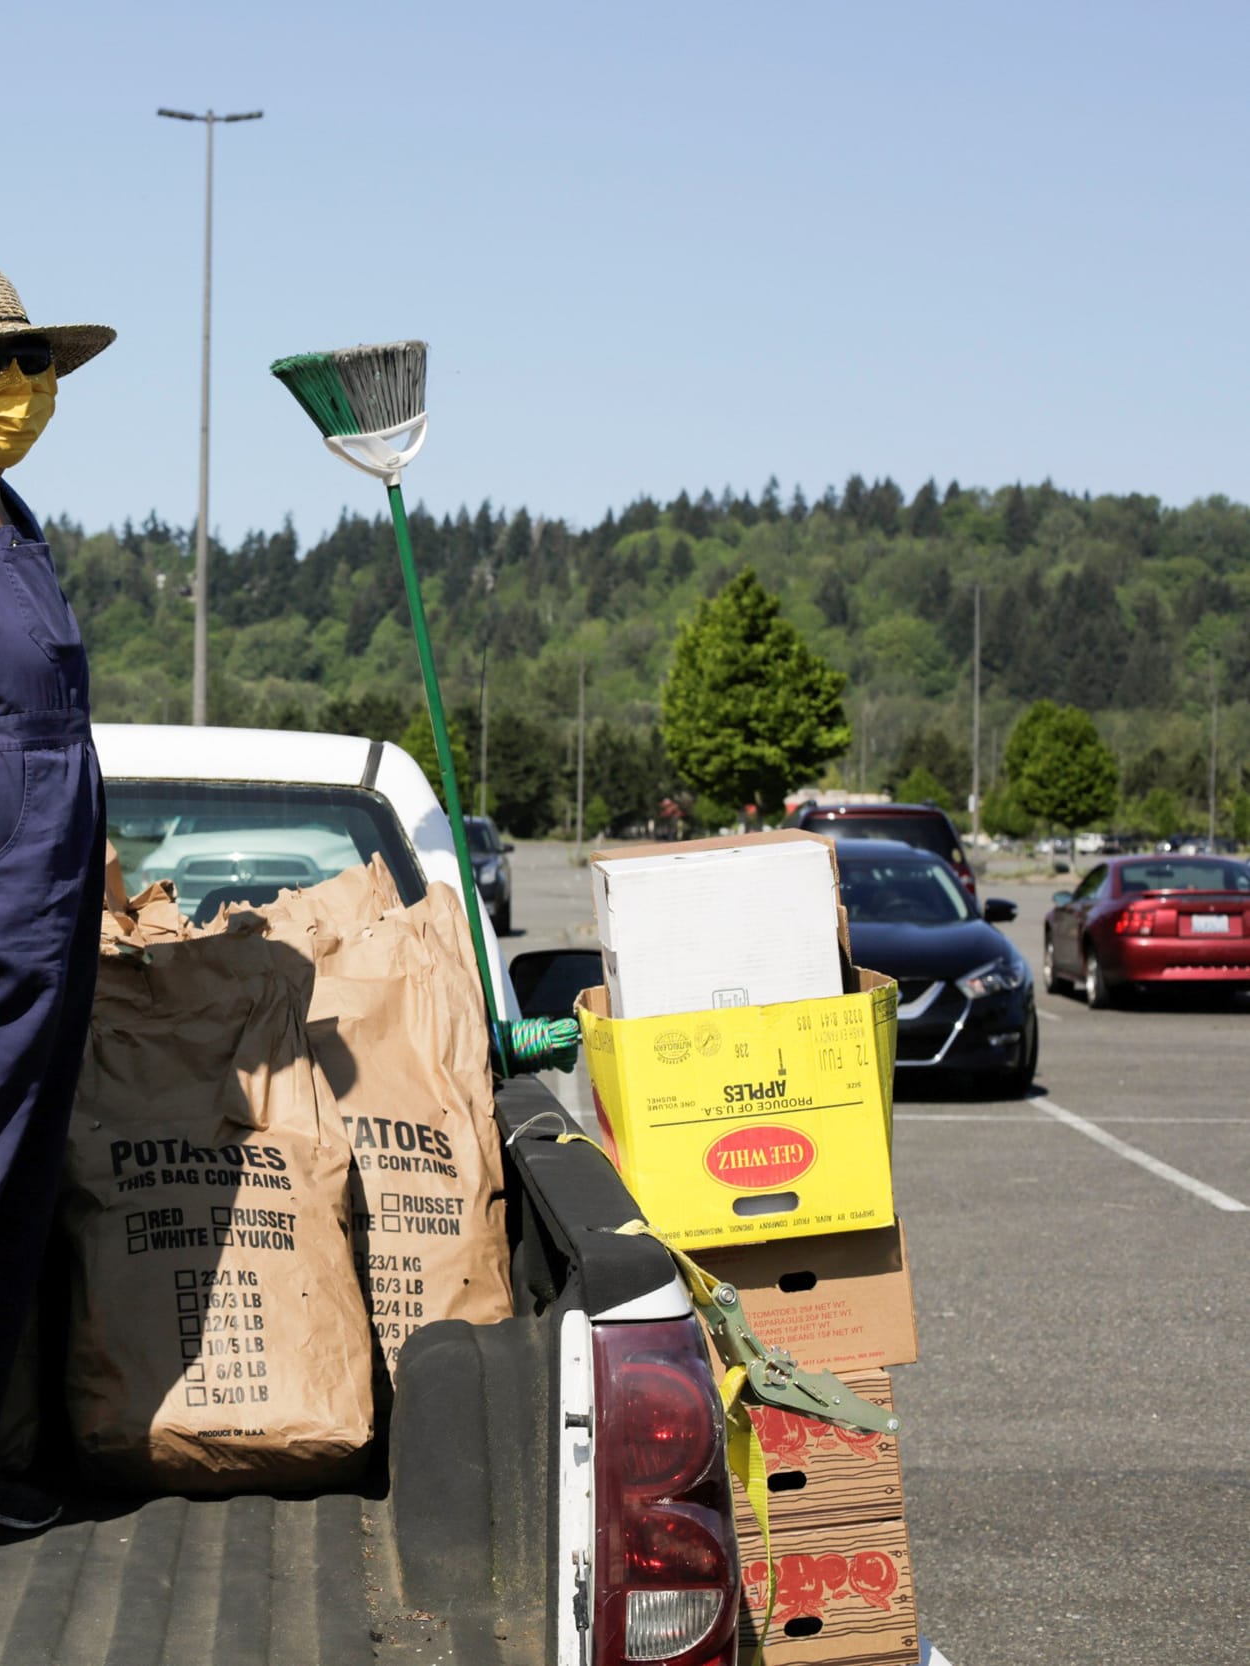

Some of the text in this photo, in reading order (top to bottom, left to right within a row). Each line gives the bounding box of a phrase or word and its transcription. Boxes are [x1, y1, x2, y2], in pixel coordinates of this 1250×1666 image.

[735, 1043, 748, 1058] 236
[818, 1044, 869, 1072] 72 FUJI
[723, 1079, 786, 1103] APPLES
[846, 1081, 862, 1089] SIZE
[646, 1096, 677, 1104] BUSHEL
[648, 1103, 678, 1111] VOLUME
[701, 1096, 813, 1116] PRODUCE OF U.S.A.
[110, 1139, 287, 1177] POTATOES
[717, 1143, 804, 1170] GEE WHIZ
[378, 1154, 458, 1178] CONTAINS
[116, 1168, 292, 1193] THIS BAG CONTAINS
[402, 1194, 464, 1216] RUSSET
[148, 1207, 297, 1232] RED RUSSET
[793, 1218, 810, 1226] FRUIT
[850, 1210, 875, 1219] SHIPPED
[352, 1213, 461, 1236] ITE YUKON
[684, 1227, 723, 1238] WASHINGTON
[759, 1220, 788, 1230] COMPANY
[151, 1227, 295, 1251] WHITE YUKON
[369, 1254, 422, 1272] 23/1 KG
[201, 1270, 258, 1287] 23/1 KG
[406, 1279, 424, 1295] LB
[202, 1292, 262, 1309] 16/3 LB
[405, 1301, 423, 1318] LB
[752, 1307, 797, 1319] TOMATOES
[815, 1303, 831, 1311] NET
[205, 1315, 264, 1332] 12/4 LB
[753, 1316, 804, 1328] ASPARAGUS
[806, 1313, 819, 1321] 20#
[822, 1311, 837, 1320] NET
[377, 1322, 400, 1339] 0/5
[755, 1328, 782, 1337] BEANS
[800, 1323, 816, 1332] NET
[787, 1333, 815, 1343] BEANS
[818, 1330, 831, 1338] 15#
[833, 1328, 849, 1336] NET
[207, 1337, 264, 1356] 10/5 LB
[216, 1361, 267, 1380] 6/8 LB
[212, 1385, 269, 1404] 5/10 LB
[198, 1429, 266, 1438] PRODUCE OF U.S.A.
